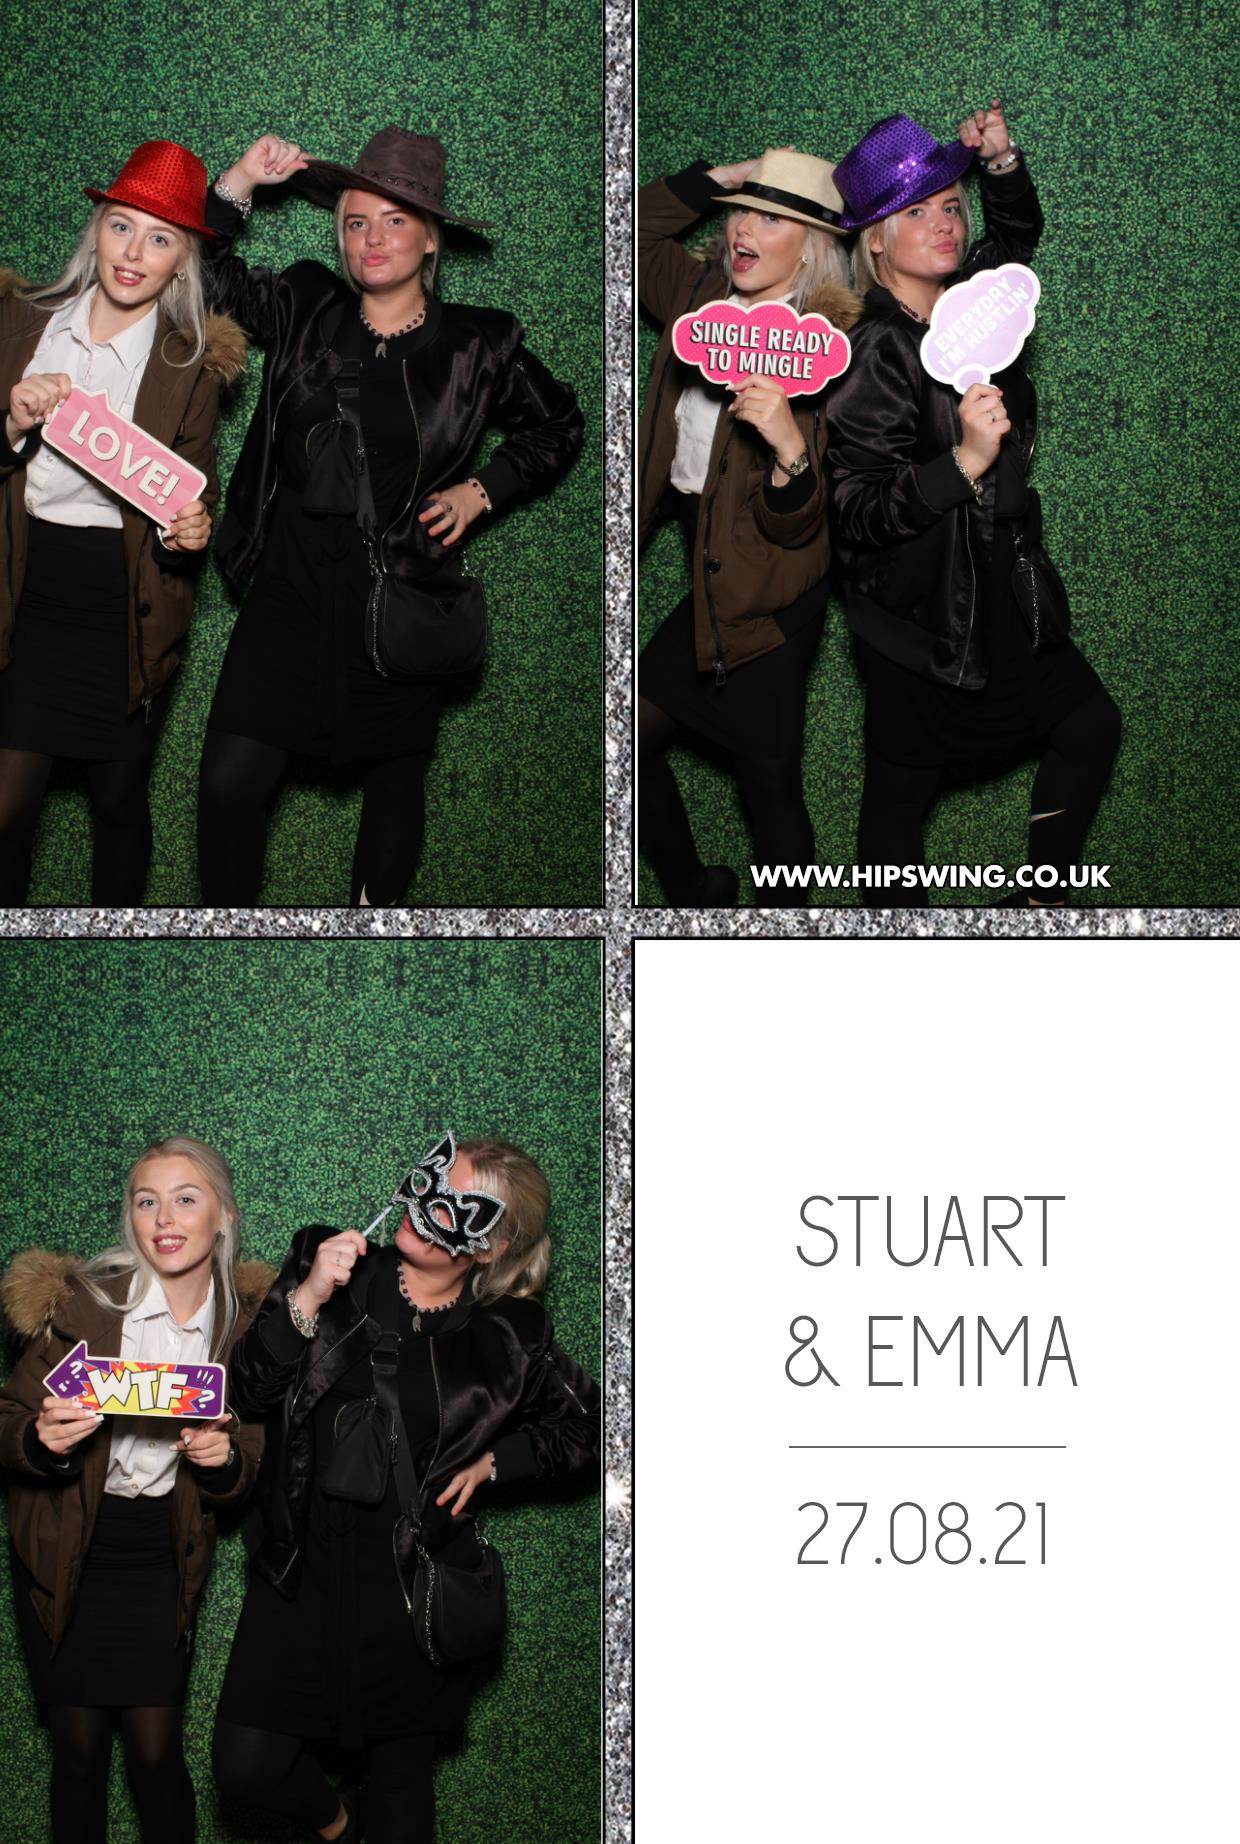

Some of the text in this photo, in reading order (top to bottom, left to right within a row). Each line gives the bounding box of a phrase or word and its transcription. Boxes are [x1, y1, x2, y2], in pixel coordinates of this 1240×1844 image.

[691, 320, 834, 355] SINGLE READY
[934, 276, 1012, 352] EVERYDAY
[939, 282, 1030, 373] I'M HUSTLIN'
[707, 348, 814, 380] TO MINGLE
[68, 409, 180, 506] LOVE!
[87, 1367, 188, 1411] WTF
